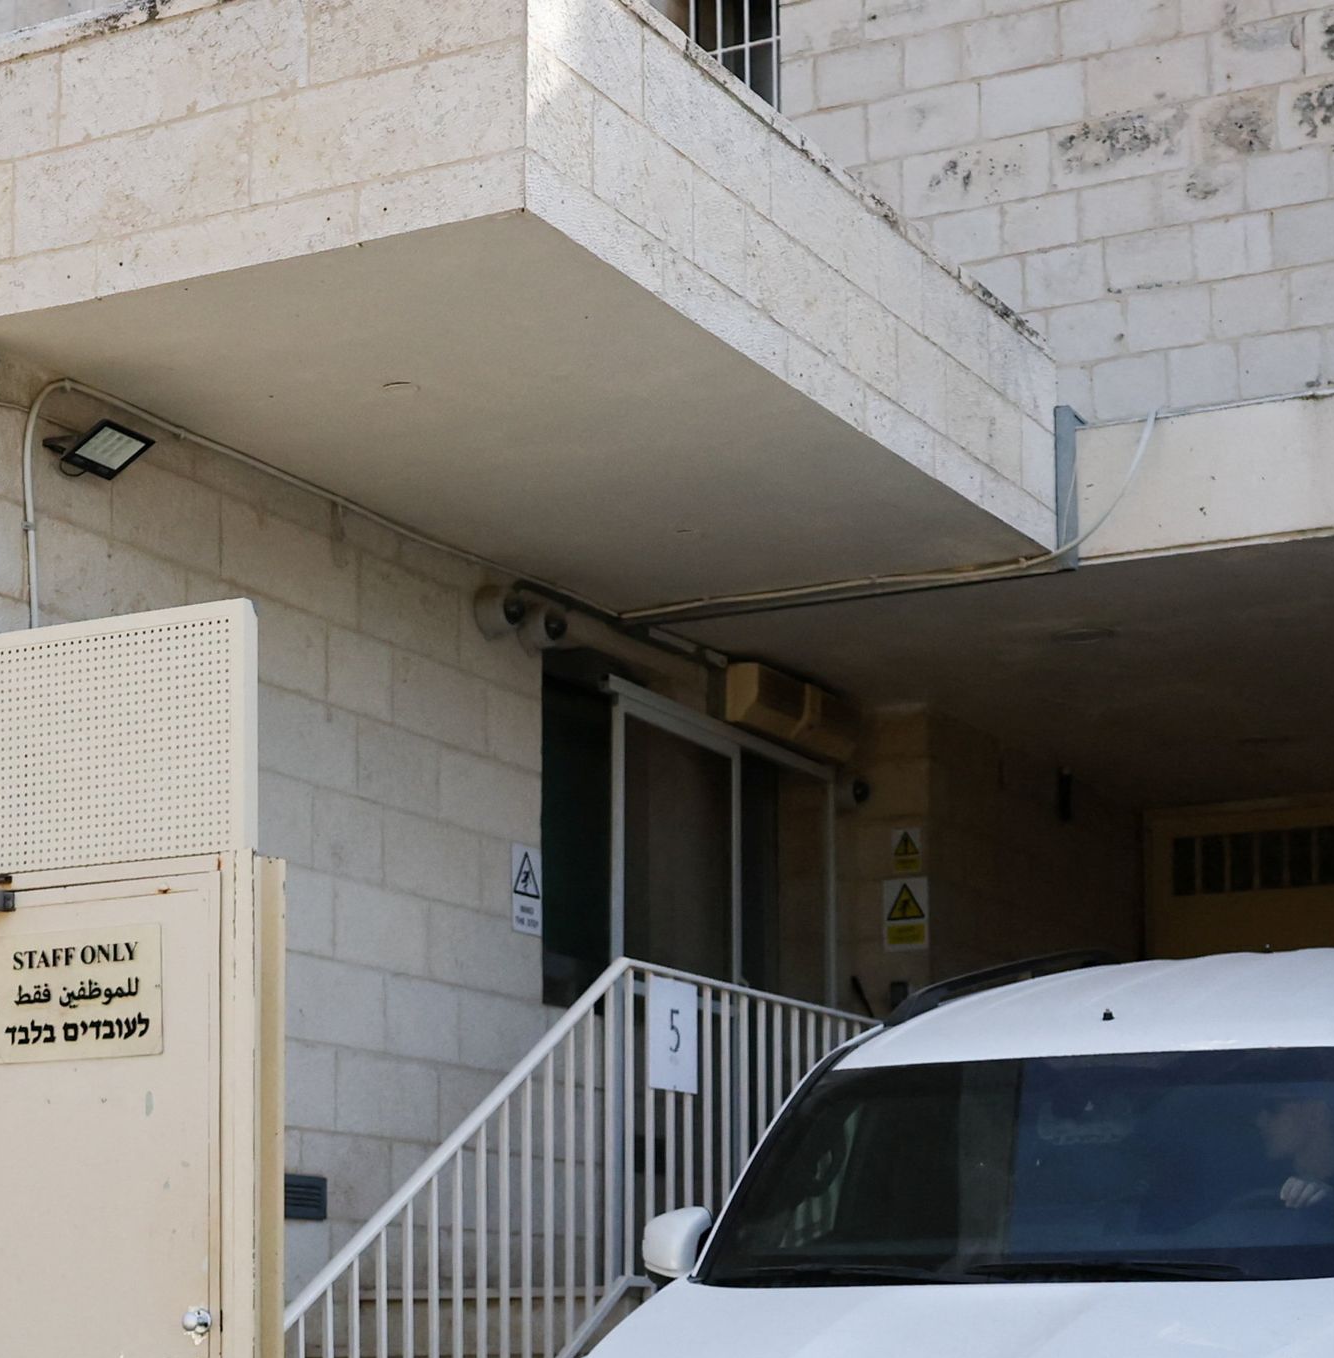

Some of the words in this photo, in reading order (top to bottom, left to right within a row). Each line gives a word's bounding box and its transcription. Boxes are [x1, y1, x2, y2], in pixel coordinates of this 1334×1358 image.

[13, 947, 75, 971] STAFF
[80, 942, 138, 965] ONLY
[14, 983, 51, 1006] فقط
[59, 976, 139, 1008] للموظفين
[5, 1019, 56, 1045] בלבד
[62, 1012, 150, 1041] לעובדים
[669, 1008, 680, 1053] 5
